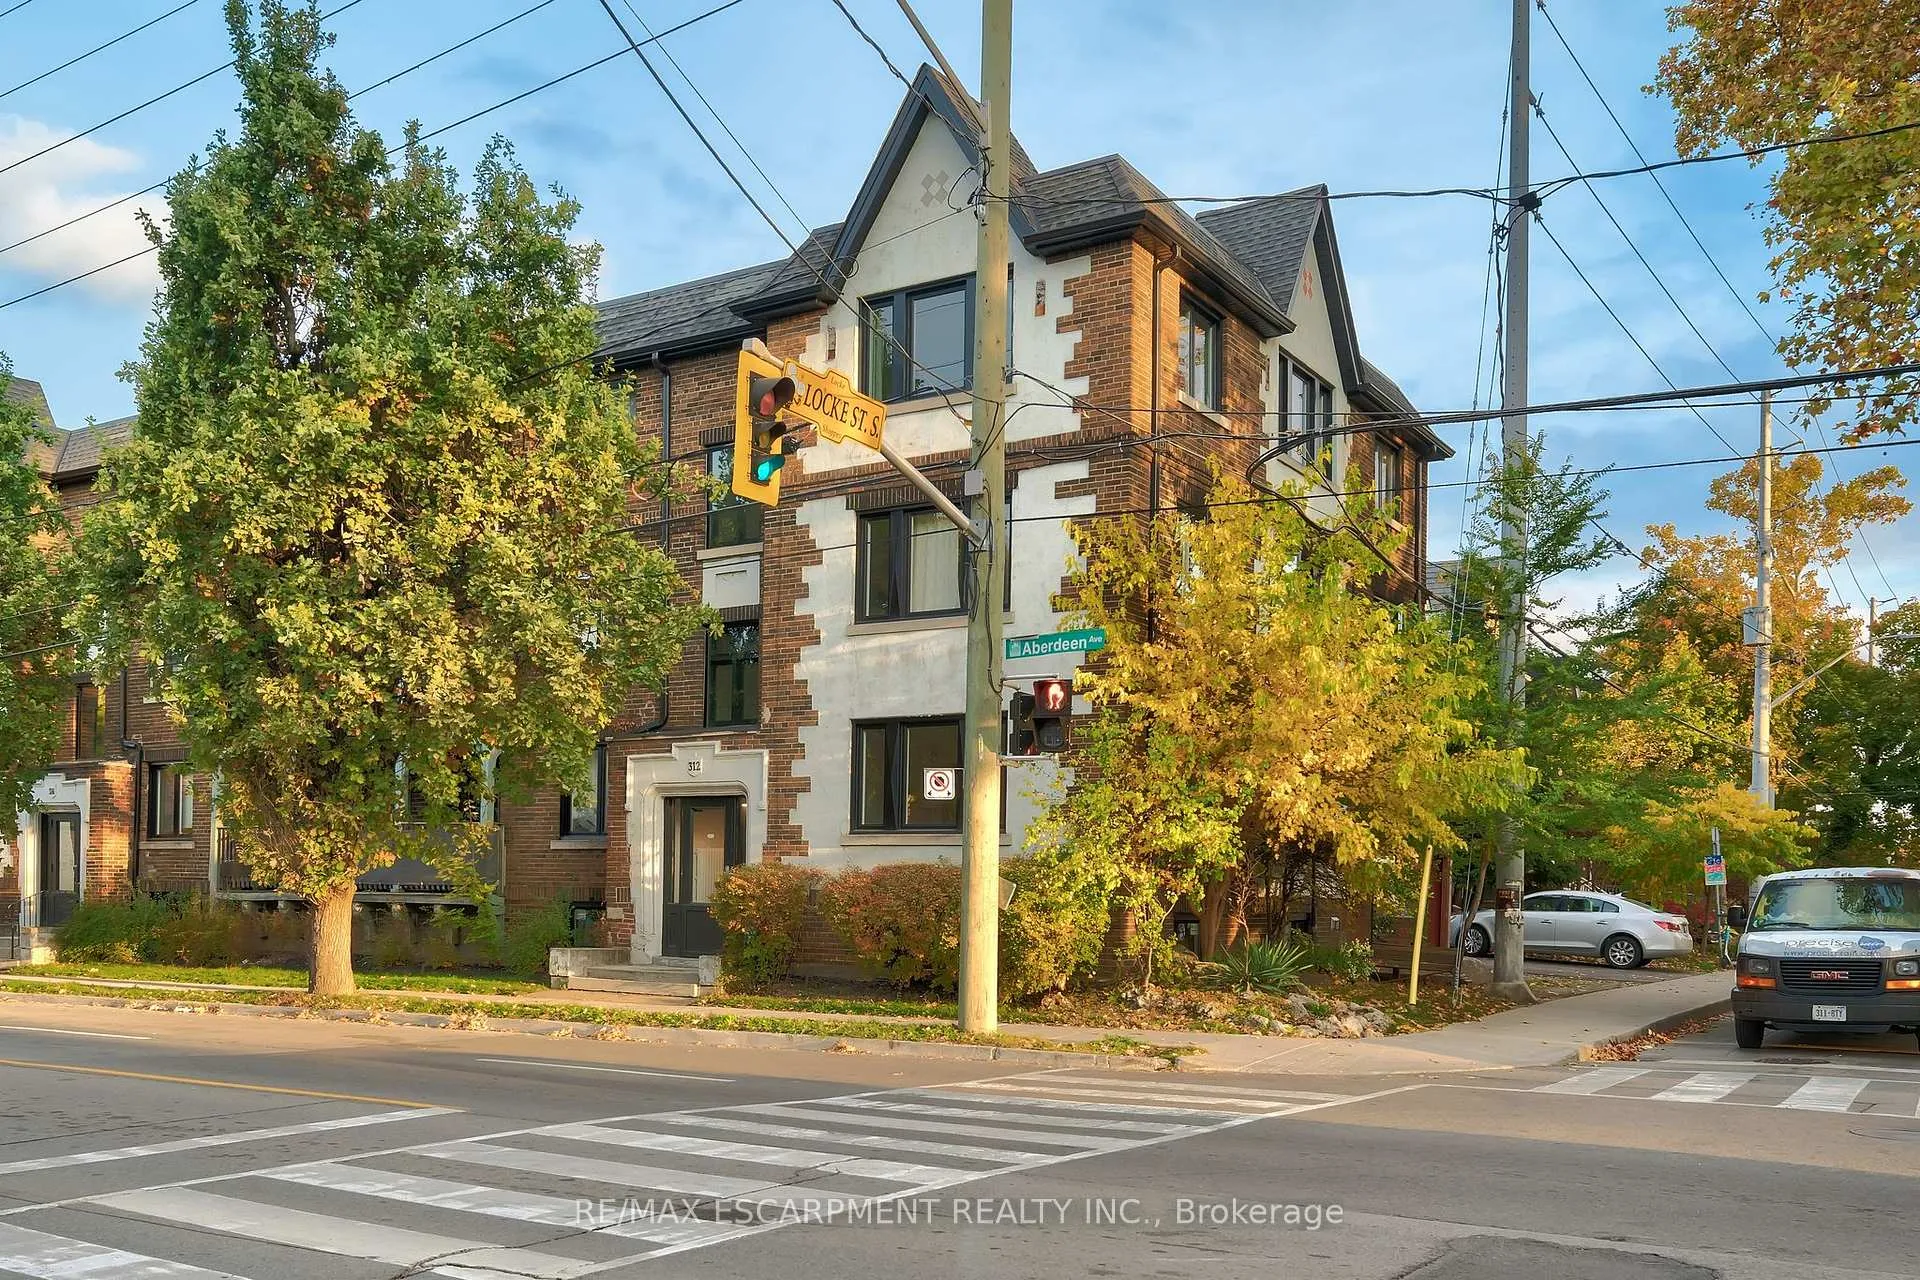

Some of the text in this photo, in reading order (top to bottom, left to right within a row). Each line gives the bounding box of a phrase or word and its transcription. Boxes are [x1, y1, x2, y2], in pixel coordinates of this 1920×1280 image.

[804, 384, 880, 438] LOCKE ST. S.
[1022, 635, 1103, 656] Aberdeen Ave
[688, 761, 701, 771] 312
[1811, 971, 1849, 979] GMC
